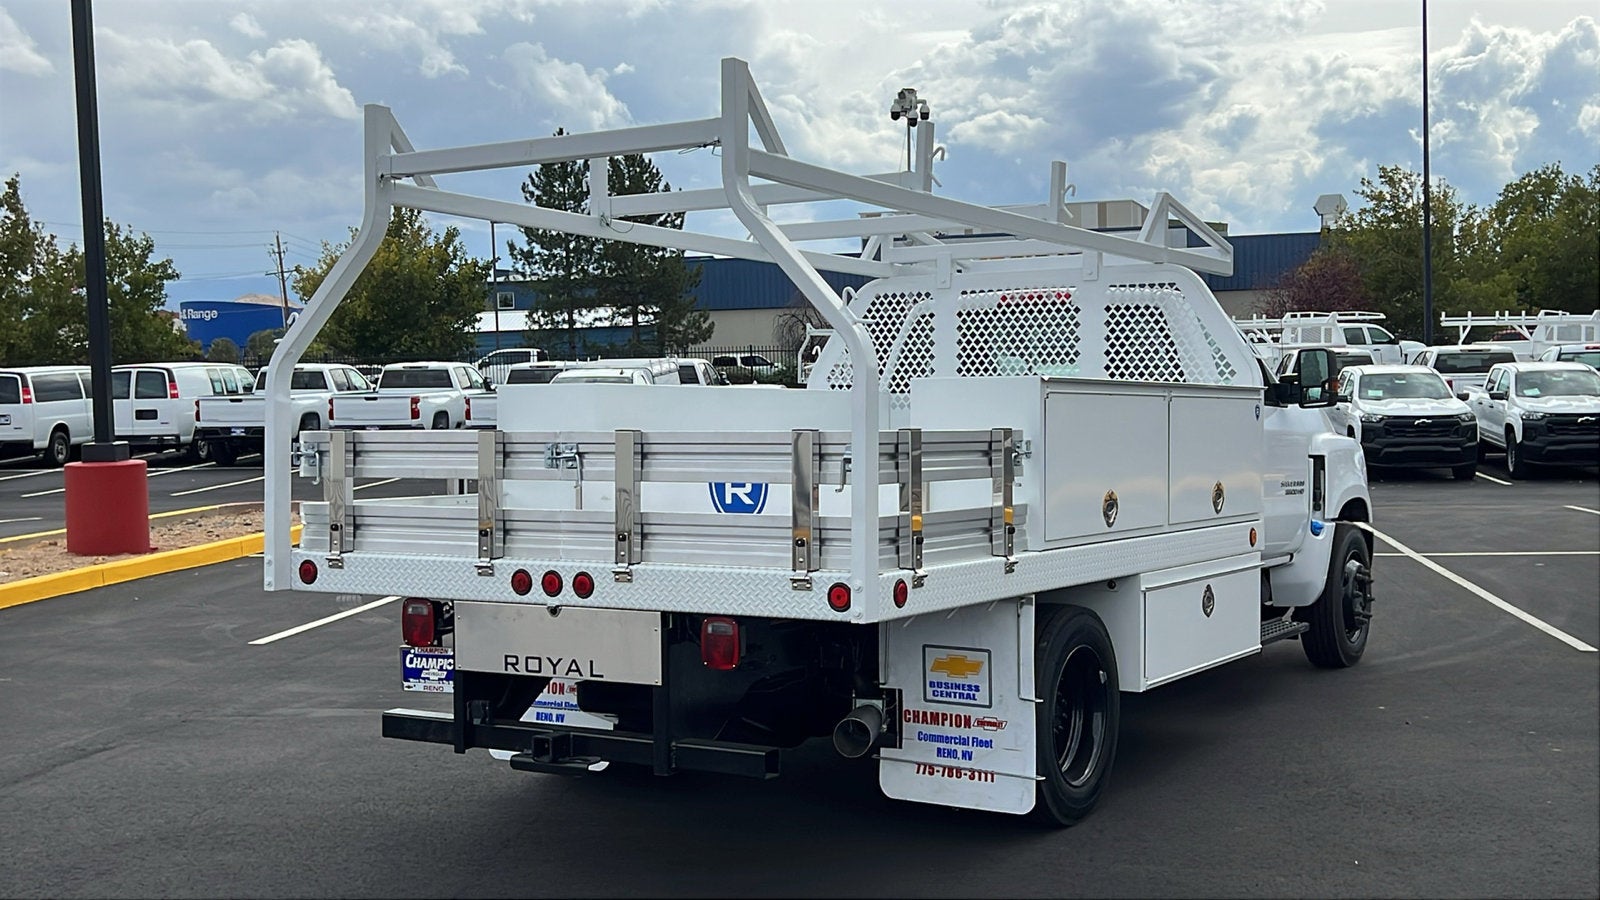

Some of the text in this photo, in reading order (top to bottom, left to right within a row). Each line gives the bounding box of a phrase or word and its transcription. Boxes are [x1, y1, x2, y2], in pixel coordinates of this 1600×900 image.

[187, 309, 218, 321] Range
[725, 483, 755, 504] R
[406, 653, 454, 670] CHAMPIO
[504, 654, 604, 679] ROYAL
[929, 680, 981, 692] BUSINESS
[932, 689, 978, 701] CENTRAL
[904, 709, 972, 729] CHAMPION
[917, 731, 993, 749] Commercial Fleet
[936, 747, 973, 761] RENO, NV
